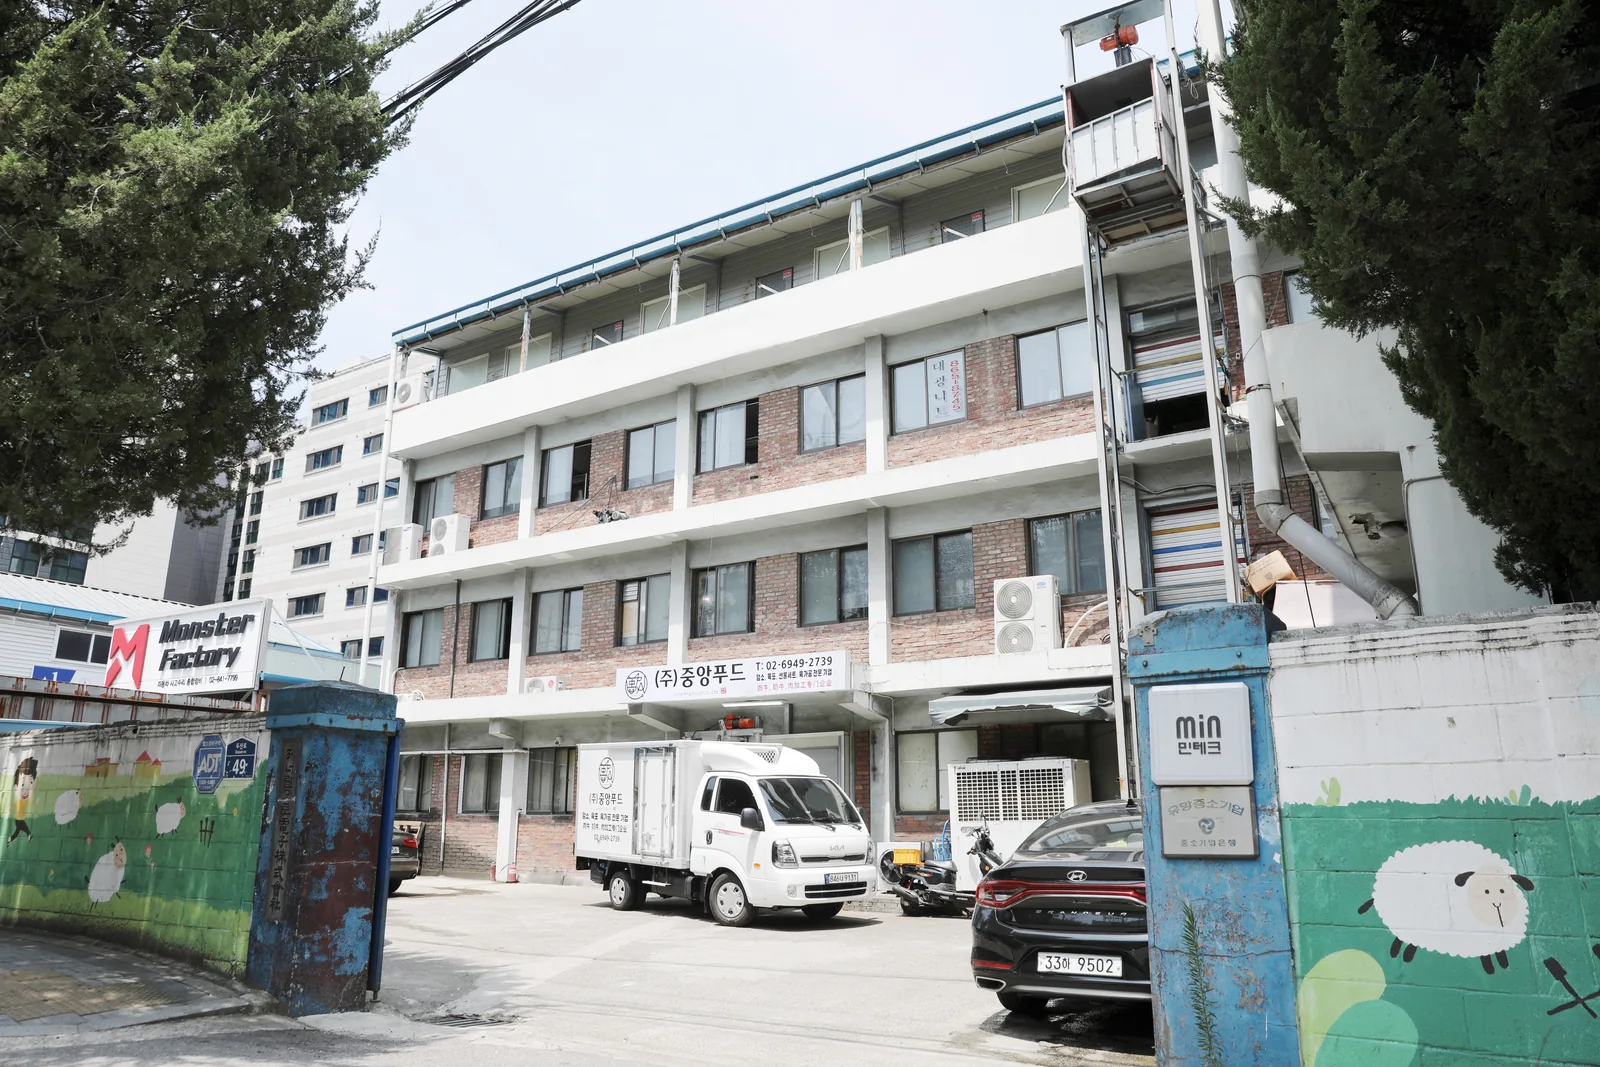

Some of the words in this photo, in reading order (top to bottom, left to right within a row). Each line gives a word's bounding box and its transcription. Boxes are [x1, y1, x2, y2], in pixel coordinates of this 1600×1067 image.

[158, 612, 255, 643] Monster
[158, 645, 241, 671] Factory
[766, 656, 833, 671] 02-6949-2739
[655, 663, 746, 688] (주)중앙푸드
[1176, 714, 1222, 739] min
[1178, 741, 1222, 755] 민테크
[199, 753, 221, 773] ADT
[232, 758, 247, 774] 49
[589, 792, 623, 806] (주)중앙푸드
[1168, 798, 1245, 816] 유망중소기업
[1181, 839, 1236, 847] 중소기업은행
[1045, 955, 1071, 970] 33하
[1078, 957, 1114, 974] 9502
